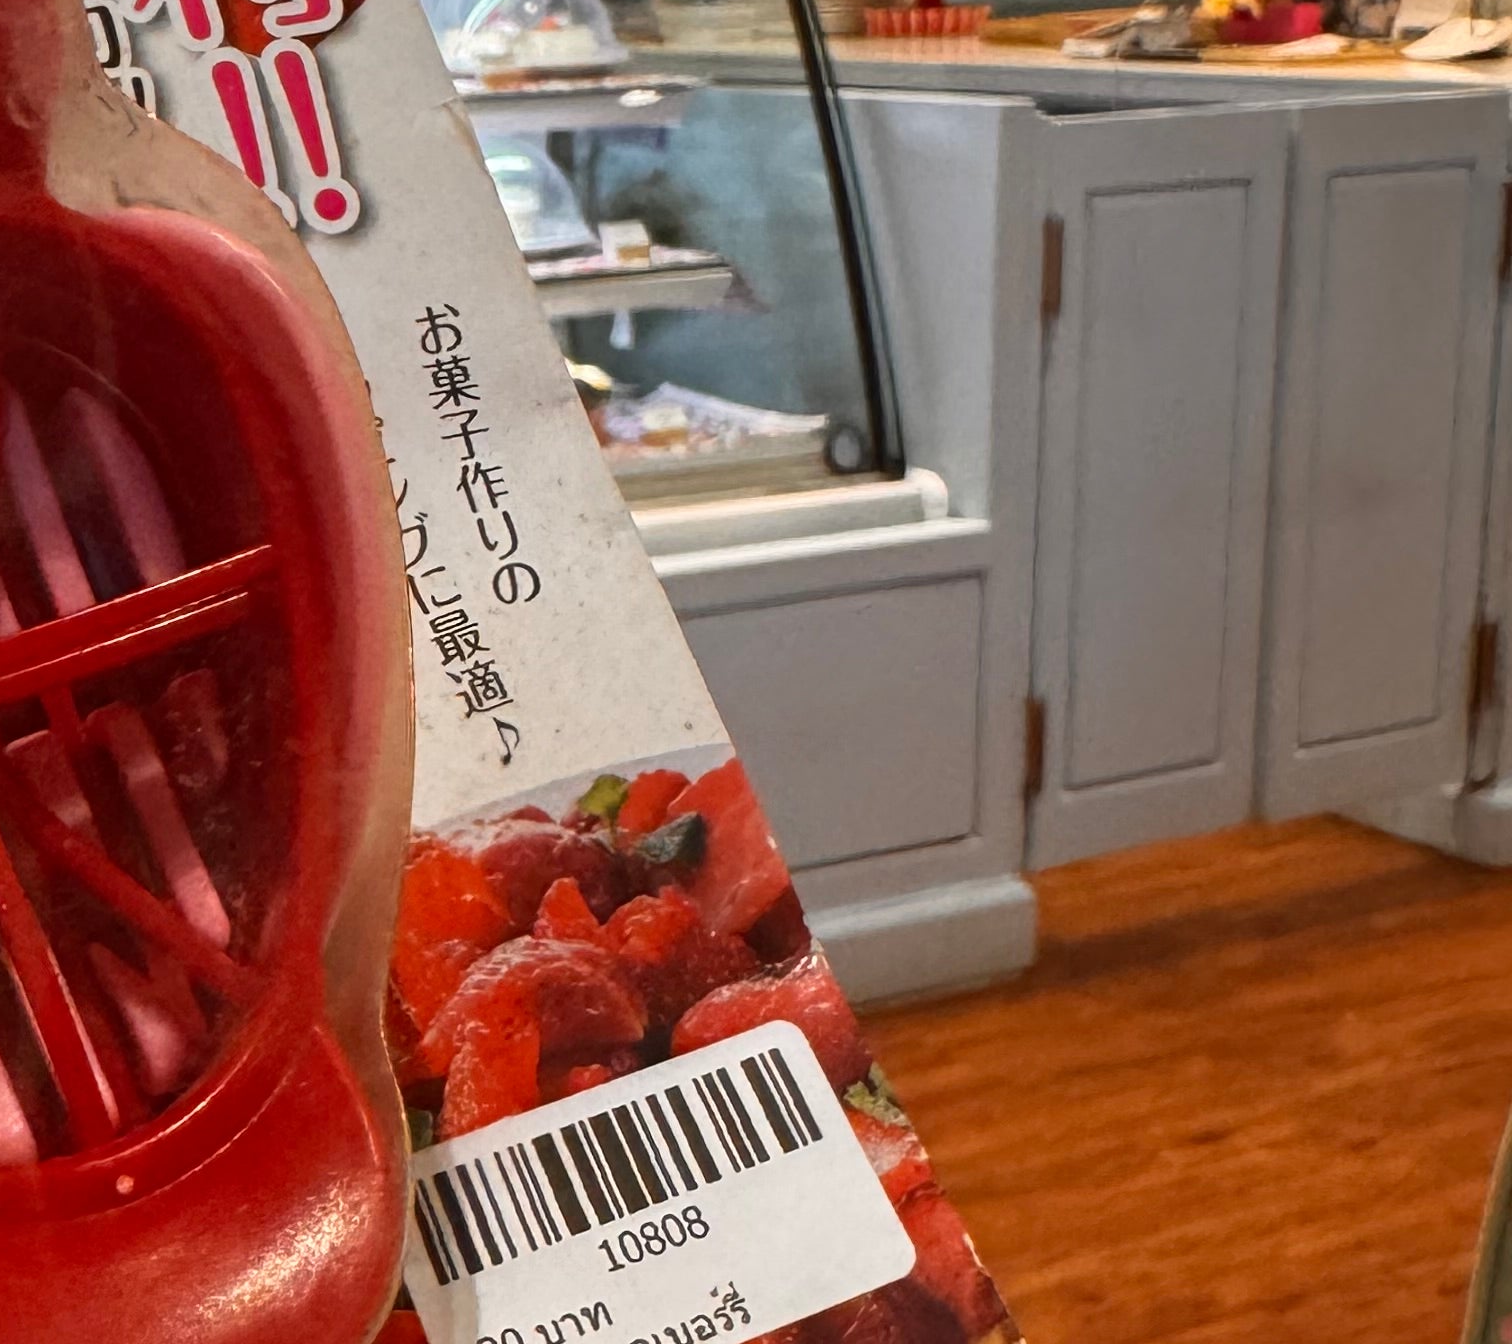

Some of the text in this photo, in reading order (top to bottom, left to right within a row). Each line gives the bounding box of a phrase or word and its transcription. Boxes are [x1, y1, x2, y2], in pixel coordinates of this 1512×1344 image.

[415, 303, 541, 605] お菓子作りの
[598, 1205, 710, 1273] 10808
